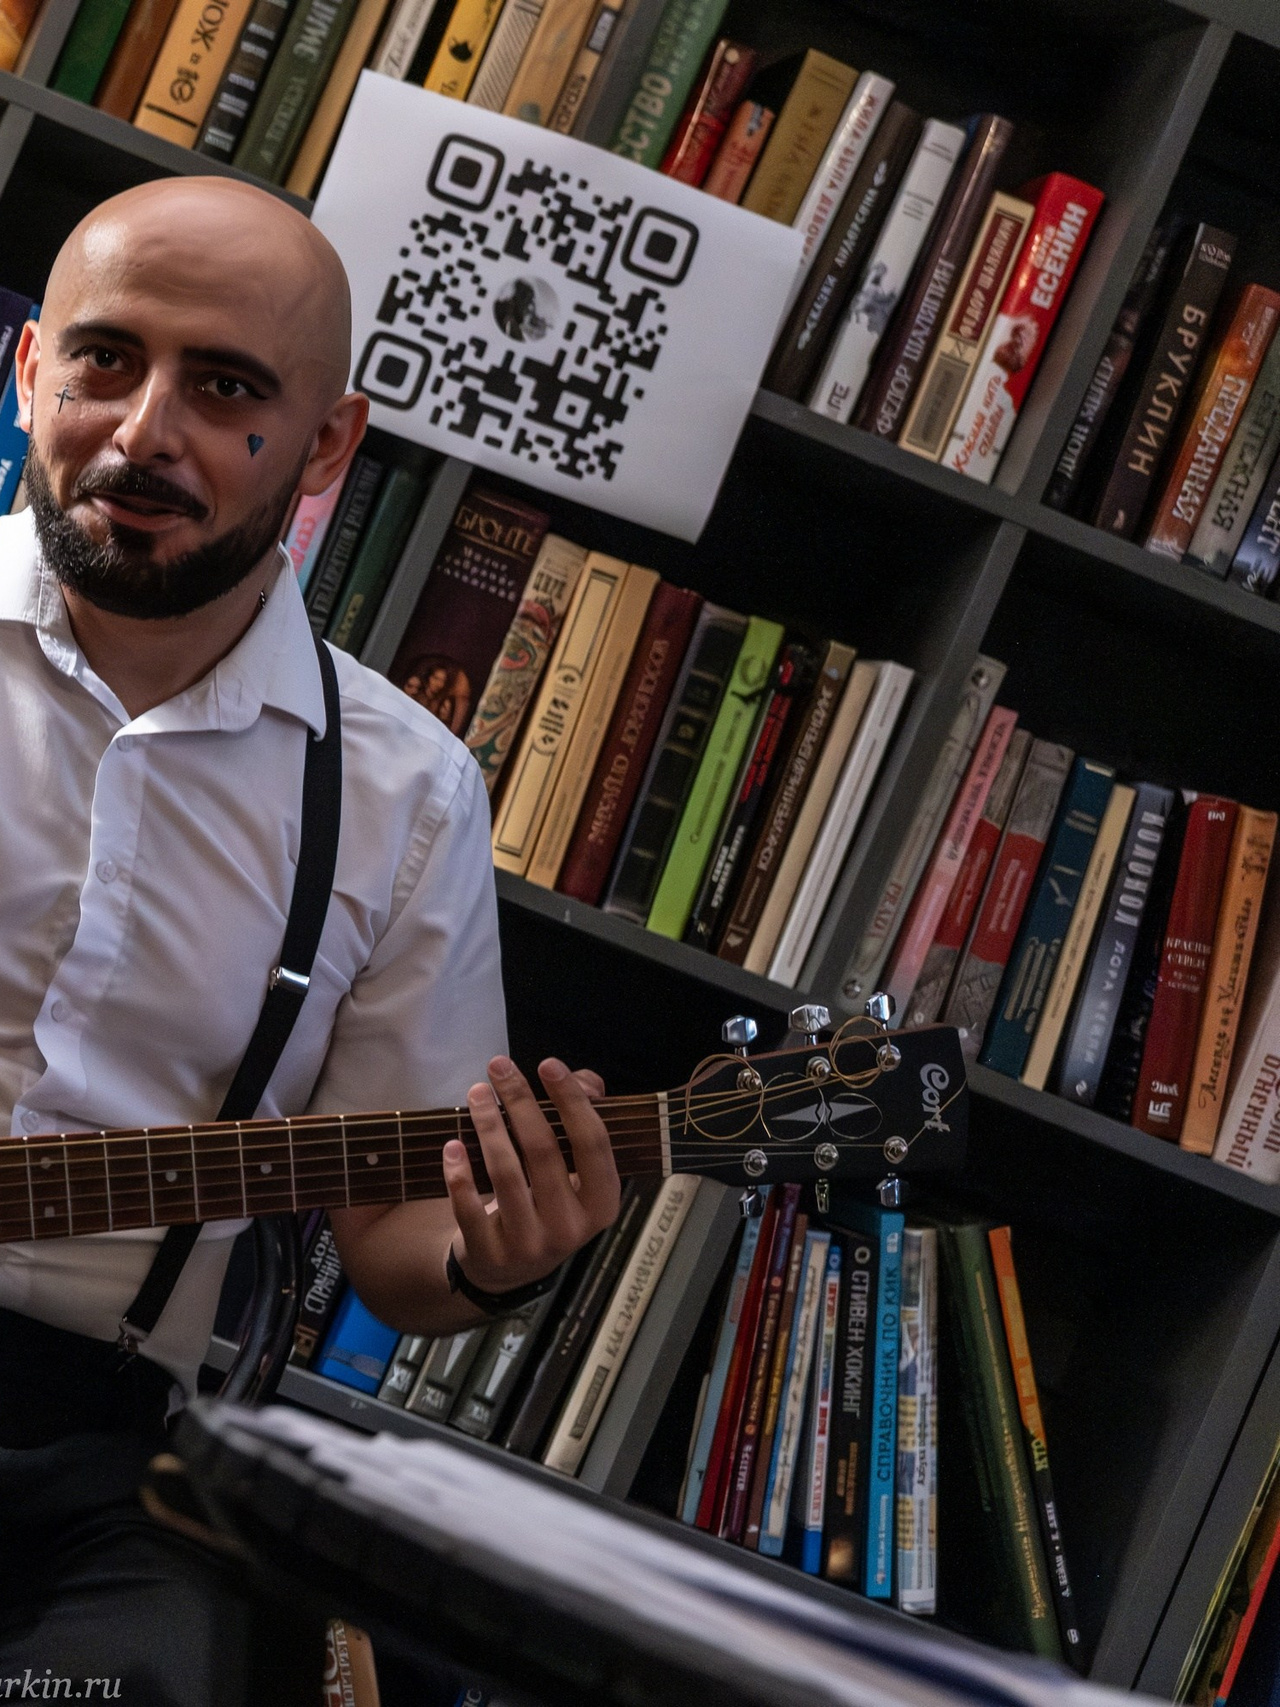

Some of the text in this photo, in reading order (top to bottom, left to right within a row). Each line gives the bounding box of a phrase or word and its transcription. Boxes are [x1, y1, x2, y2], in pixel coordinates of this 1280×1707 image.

[954, 215, 1016, 339] ФЕДОР ШАЛЯПИН
[1027, 199, 1089, 311] ЕСЕНИН
[872, 256, 956, 436] ФЕДОР ШАЛЯПИН
[1125, 302, 1208, 477] БРУКЛИН
[1168, 370, 1248, 524] ПРЕДАННАЯ
[1113, 807, 1168, 929] КОЛОКОЛ
[1101, 939, 1126, 992] ЛОРА
[920, 1062, 952, 1134] Cort
[308, 1228, 334, 1268] ДОМ
[846, 1268, 871, 1343] СТИВЕН
[841, 1343, 864, 1418] ХОКИНГ
[868, 1264, 902, 1482] СПРАВОЧНИК ПО КИК
